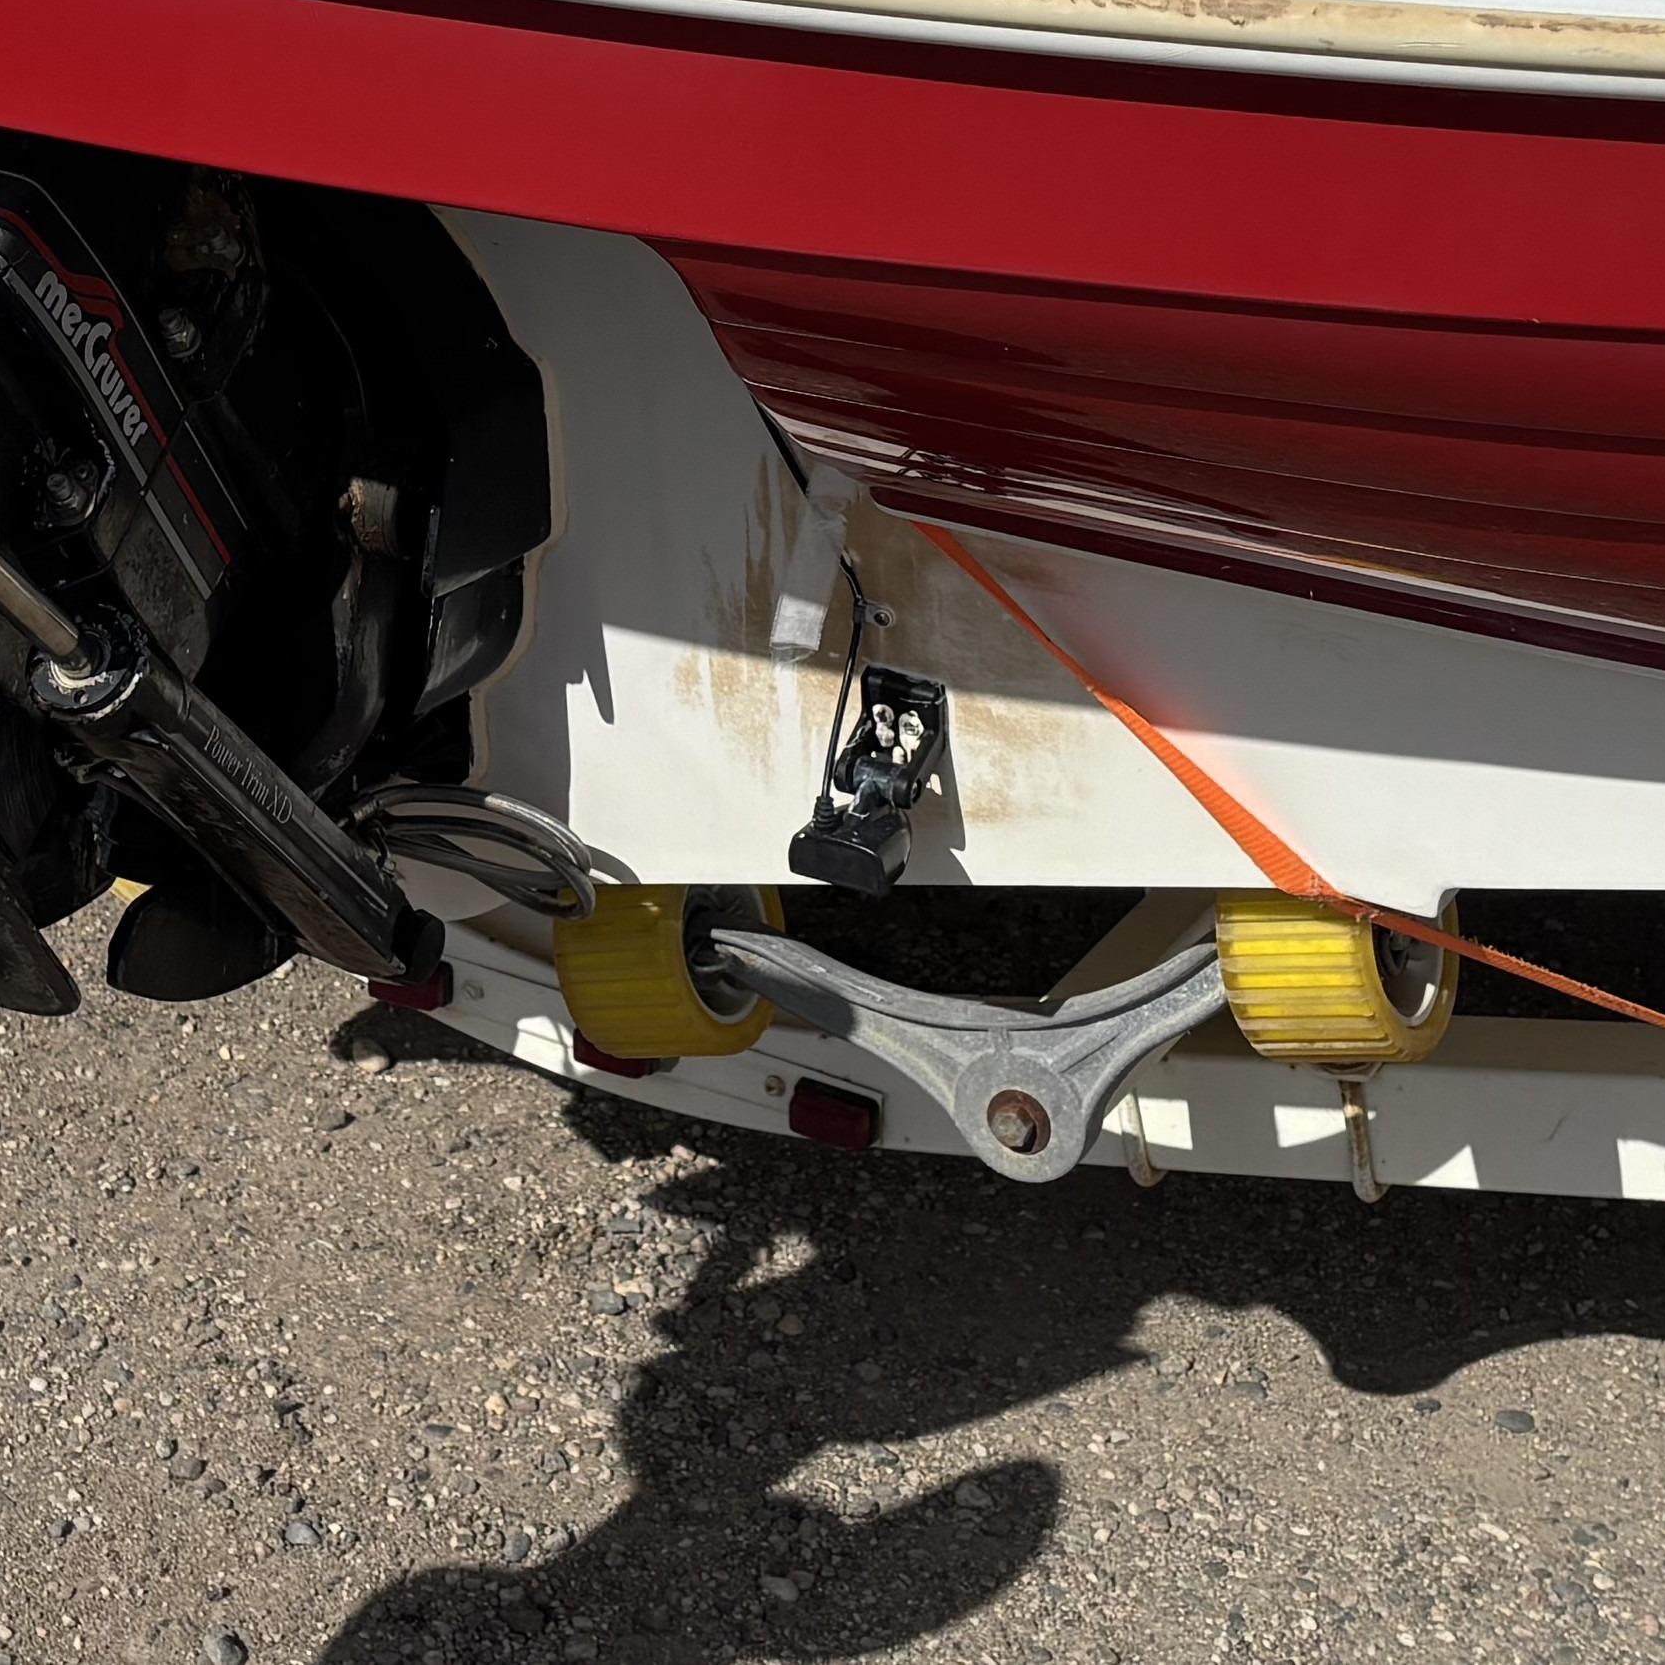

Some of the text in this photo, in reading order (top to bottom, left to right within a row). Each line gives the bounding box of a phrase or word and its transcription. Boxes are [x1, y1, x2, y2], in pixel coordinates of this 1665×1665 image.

[203, 725, 294, 824] Power Trim XD
